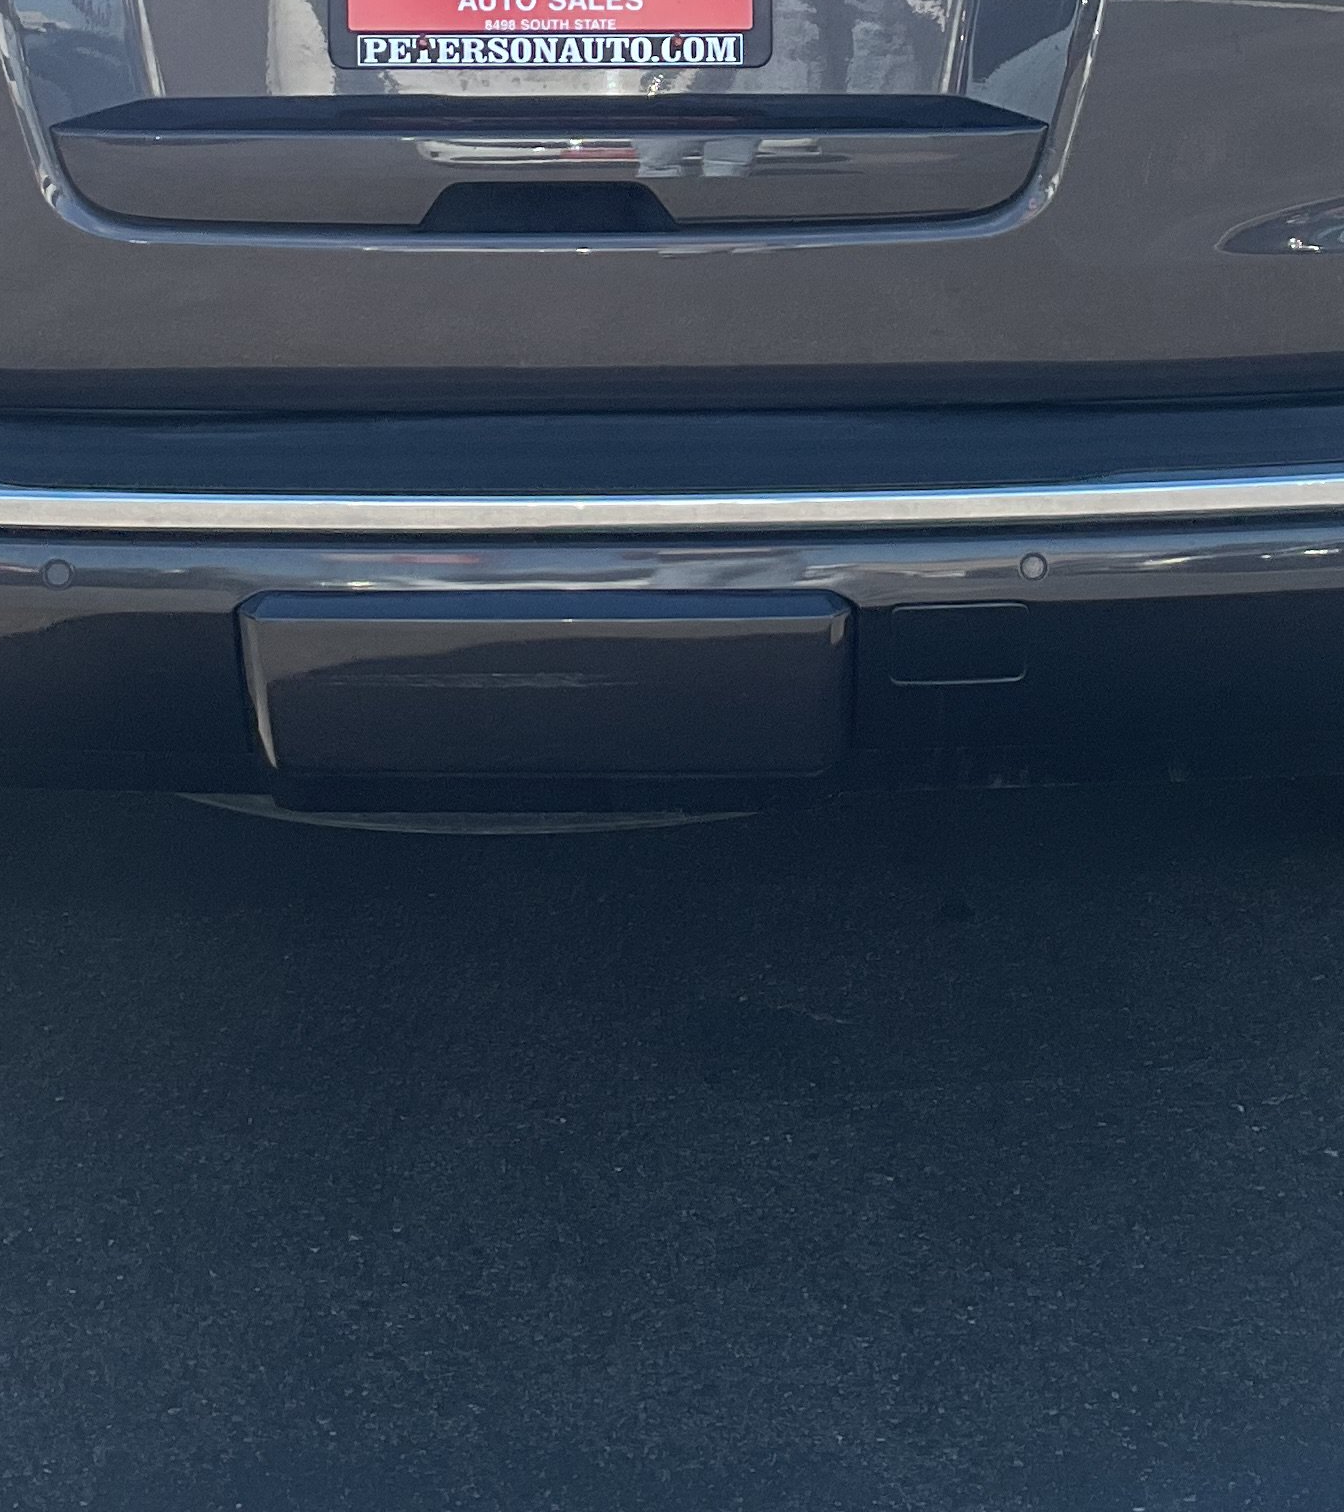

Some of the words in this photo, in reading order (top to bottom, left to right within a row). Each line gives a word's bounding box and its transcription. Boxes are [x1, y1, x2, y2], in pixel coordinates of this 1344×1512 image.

[484, 19, 516, 31] 8498
[520, 19, 569, 30] SOUTH
[574, 18, 617, 30] STATE
[363, 37, 738, 64] PETERSONAUTO.COM
